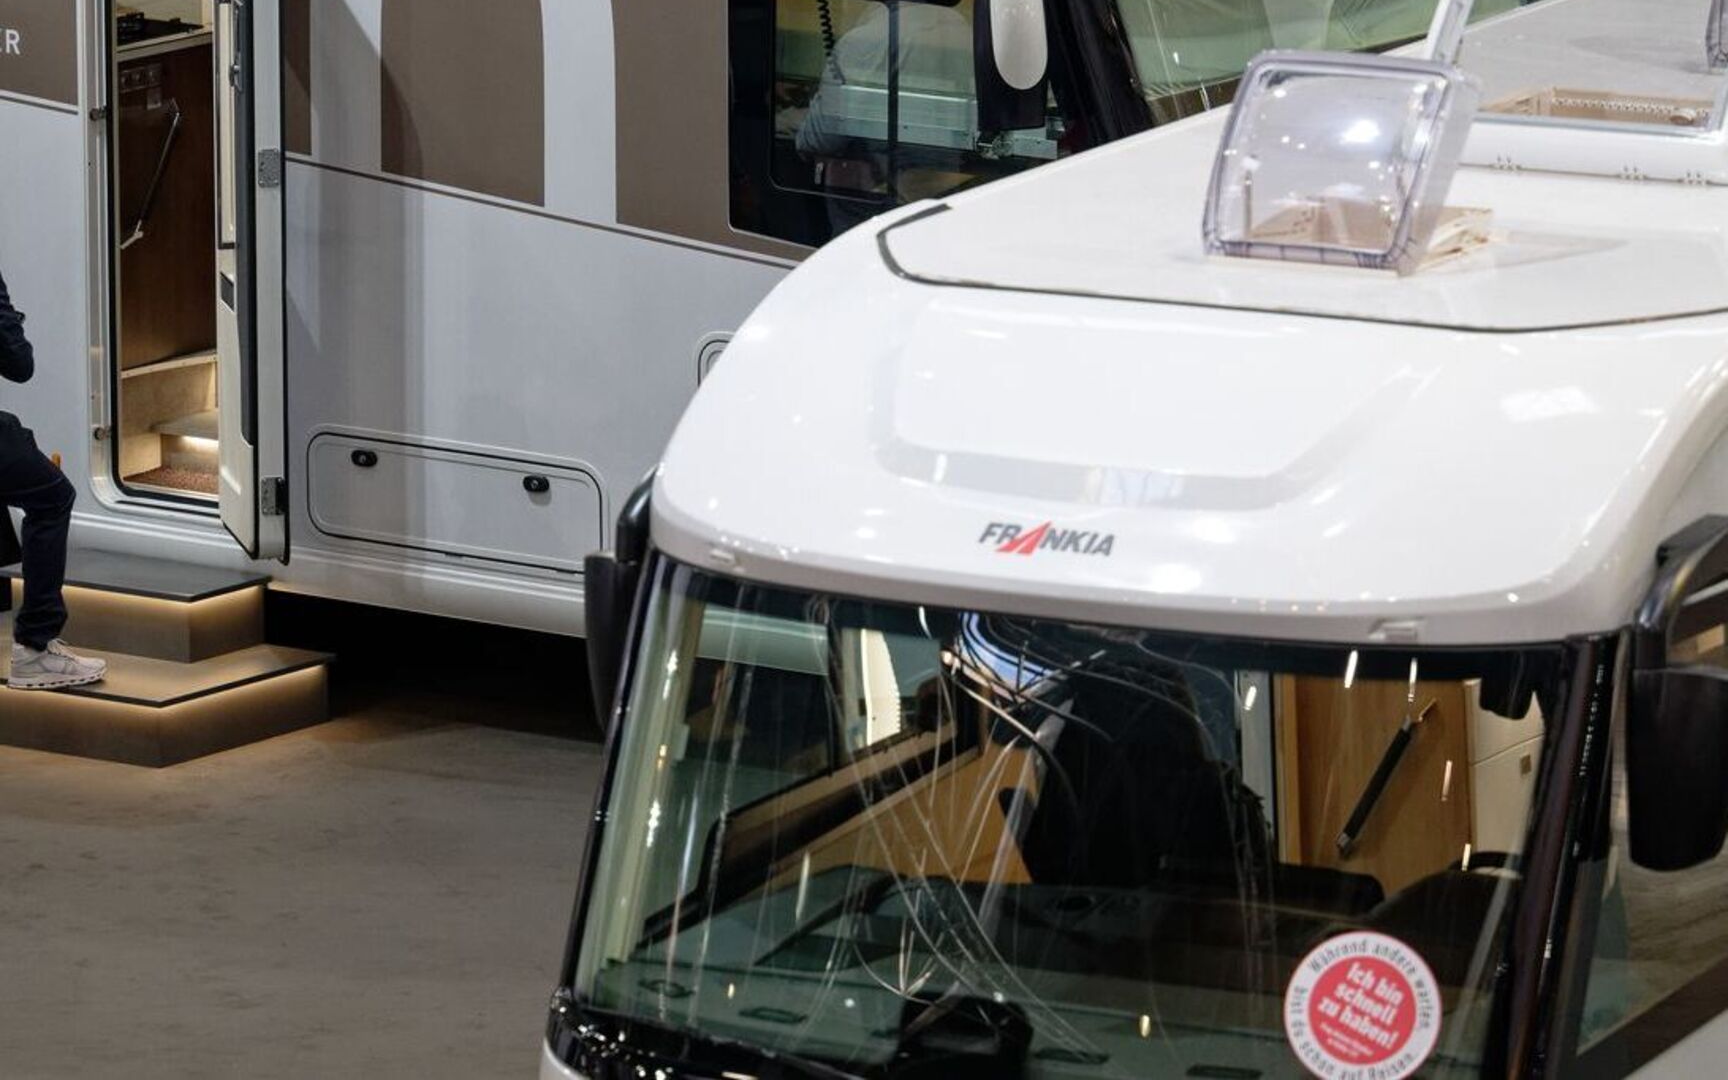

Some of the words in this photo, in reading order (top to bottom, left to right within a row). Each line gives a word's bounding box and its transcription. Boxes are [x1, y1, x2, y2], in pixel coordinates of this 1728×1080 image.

[0, 28, 21, 55] R
[978, 520, 1115, 557] FRANKIA
[1333, 982, 1398, 1027] schnell
[1346, 961, 1376, 990] Ich
[1373, 976, 1405, 1007] bin
[1317, 995, 1342, 1017] zu
[1338, 1004, 1400, 1050] haben!
